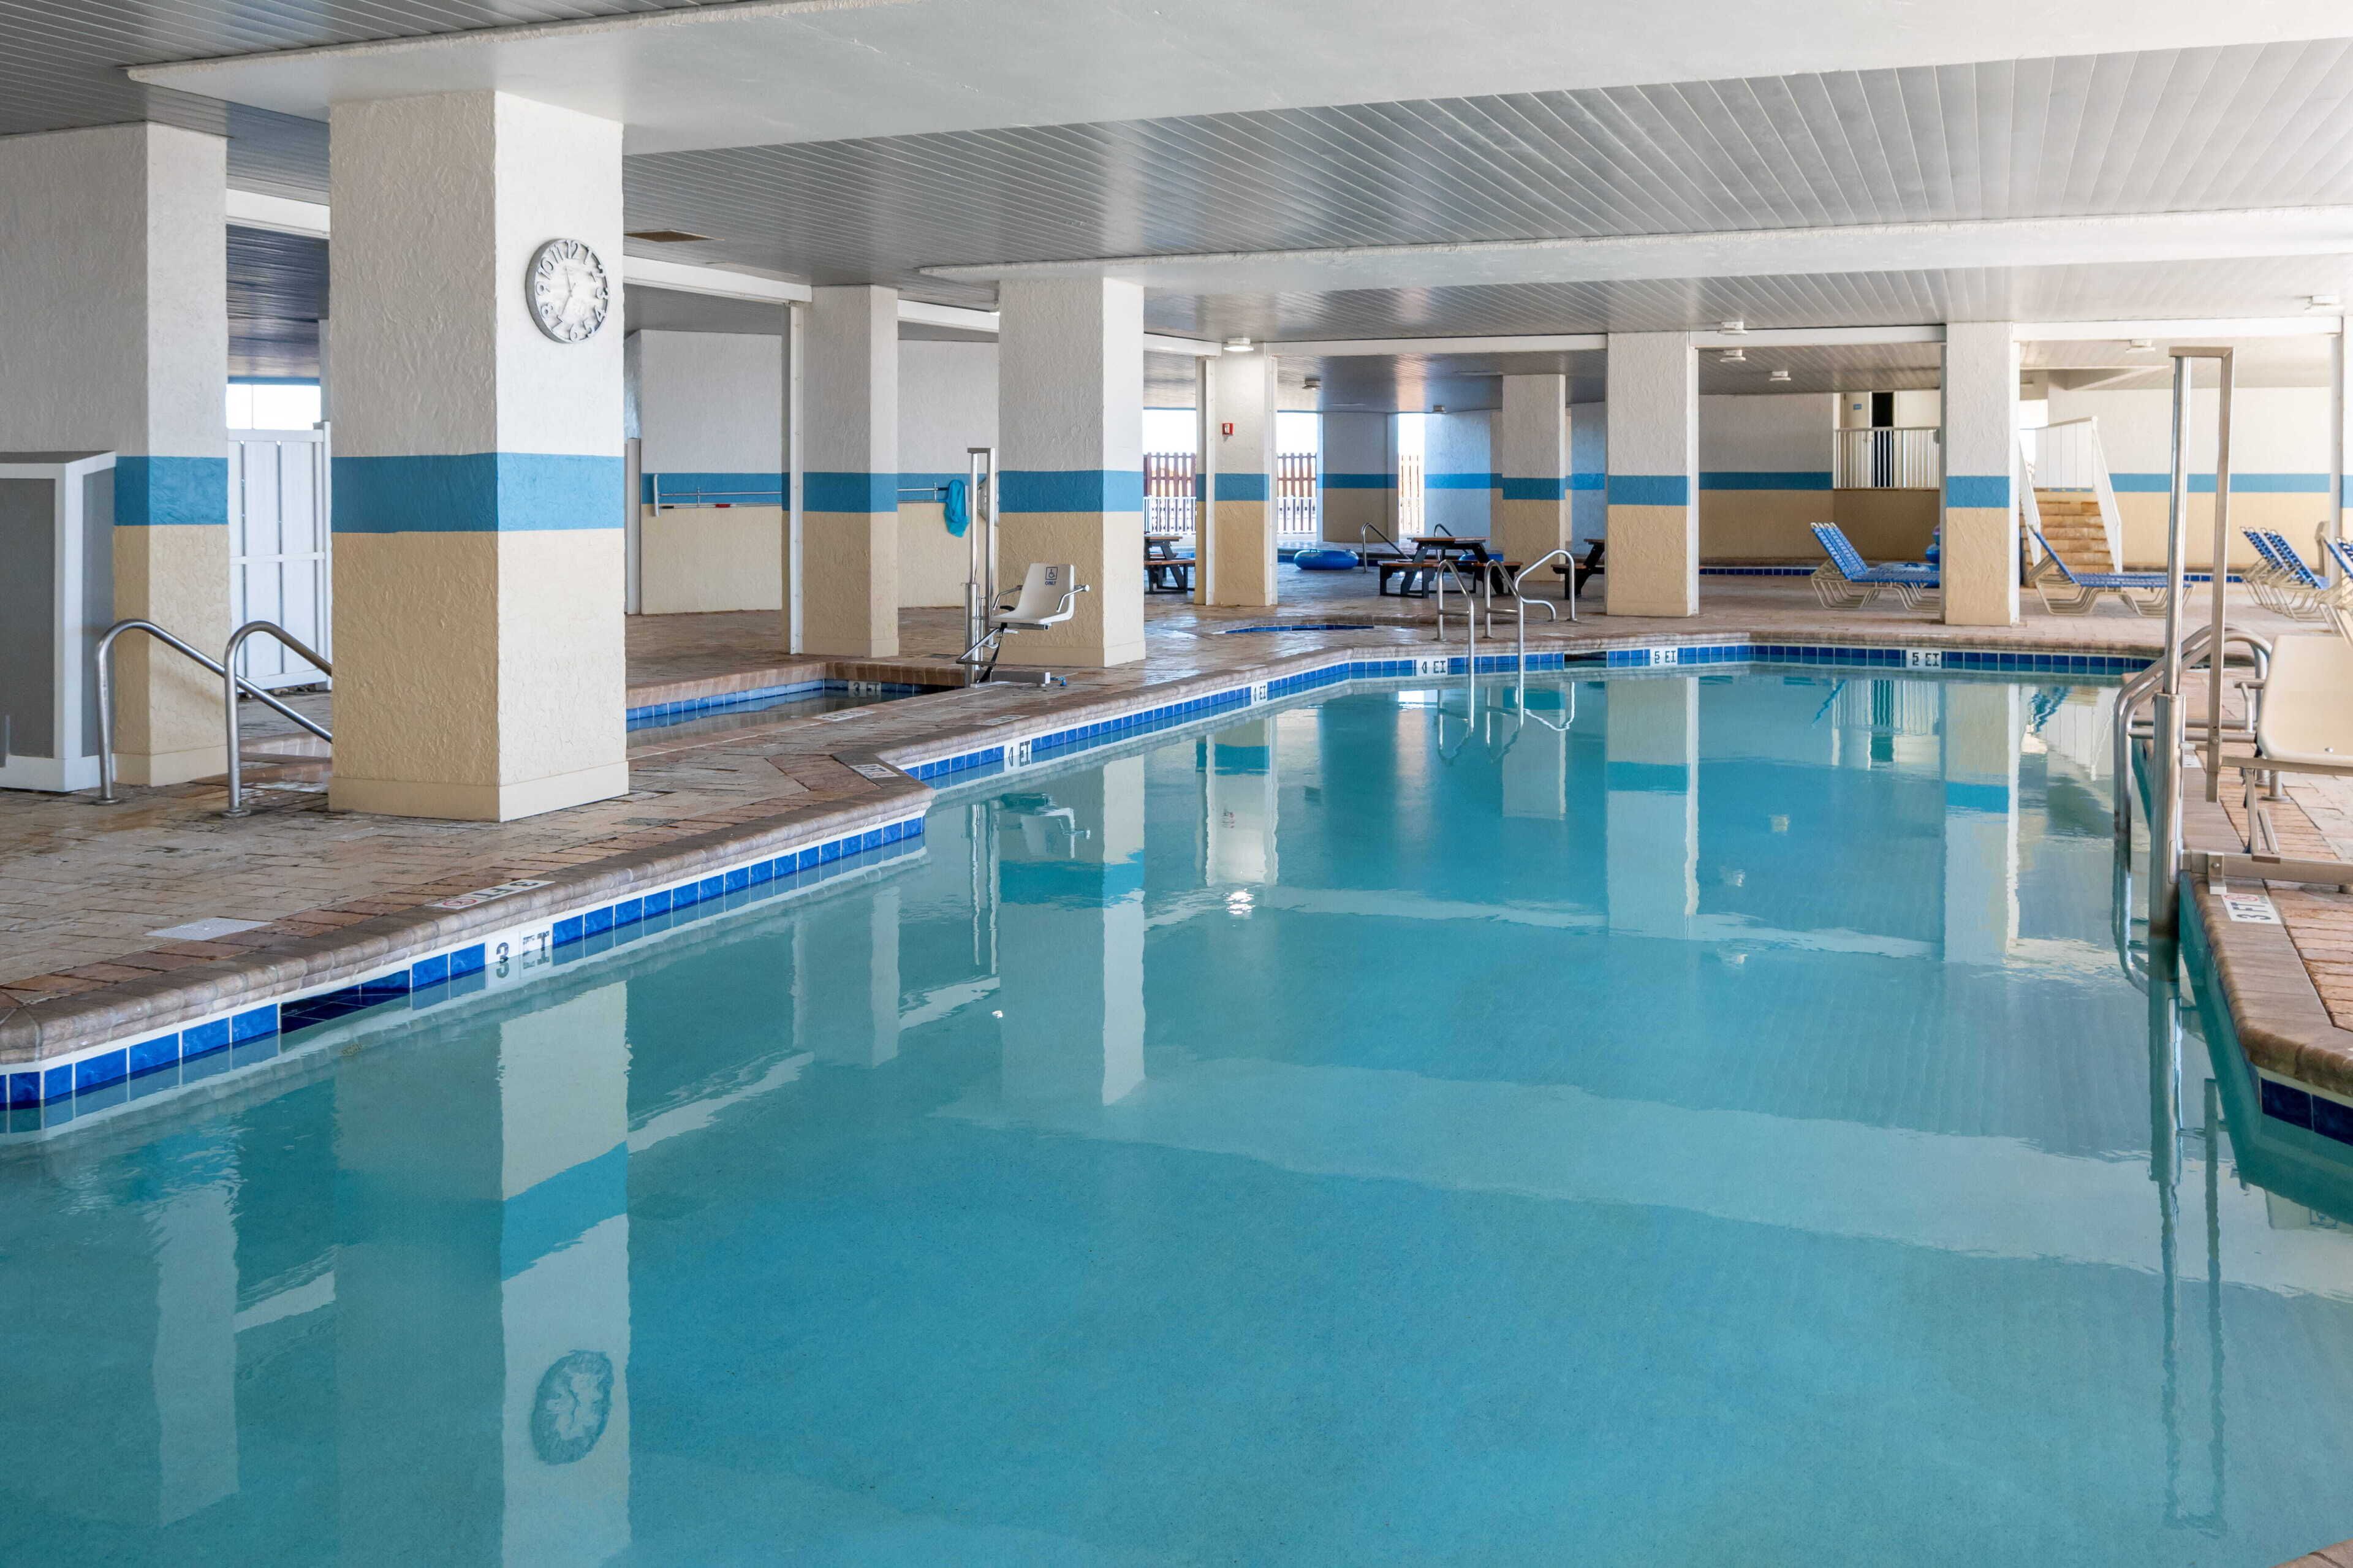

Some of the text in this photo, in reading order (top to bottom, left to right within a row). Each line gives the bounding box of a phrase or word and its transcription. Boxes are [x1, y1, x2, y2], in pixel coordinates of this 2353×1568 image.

[550, 244, 563, 263] 11
[566, 240, 578, 259] 12
[537, 257, 553, 280] 10
[536, 281, 550, 295] 9
[596, 287, 608, 300] 3
[540, 303, 553, 319] 8
[594, 305, 605, 323] 4
[551, 314, 564, 332] 7
[583, 317, 596, 338] 5
[569, 323, 580, 343] 6
[472, 888, 514, 898] FT
[2230, 902, 2268, 912] FT
[496, 942, 509, 974] 3
